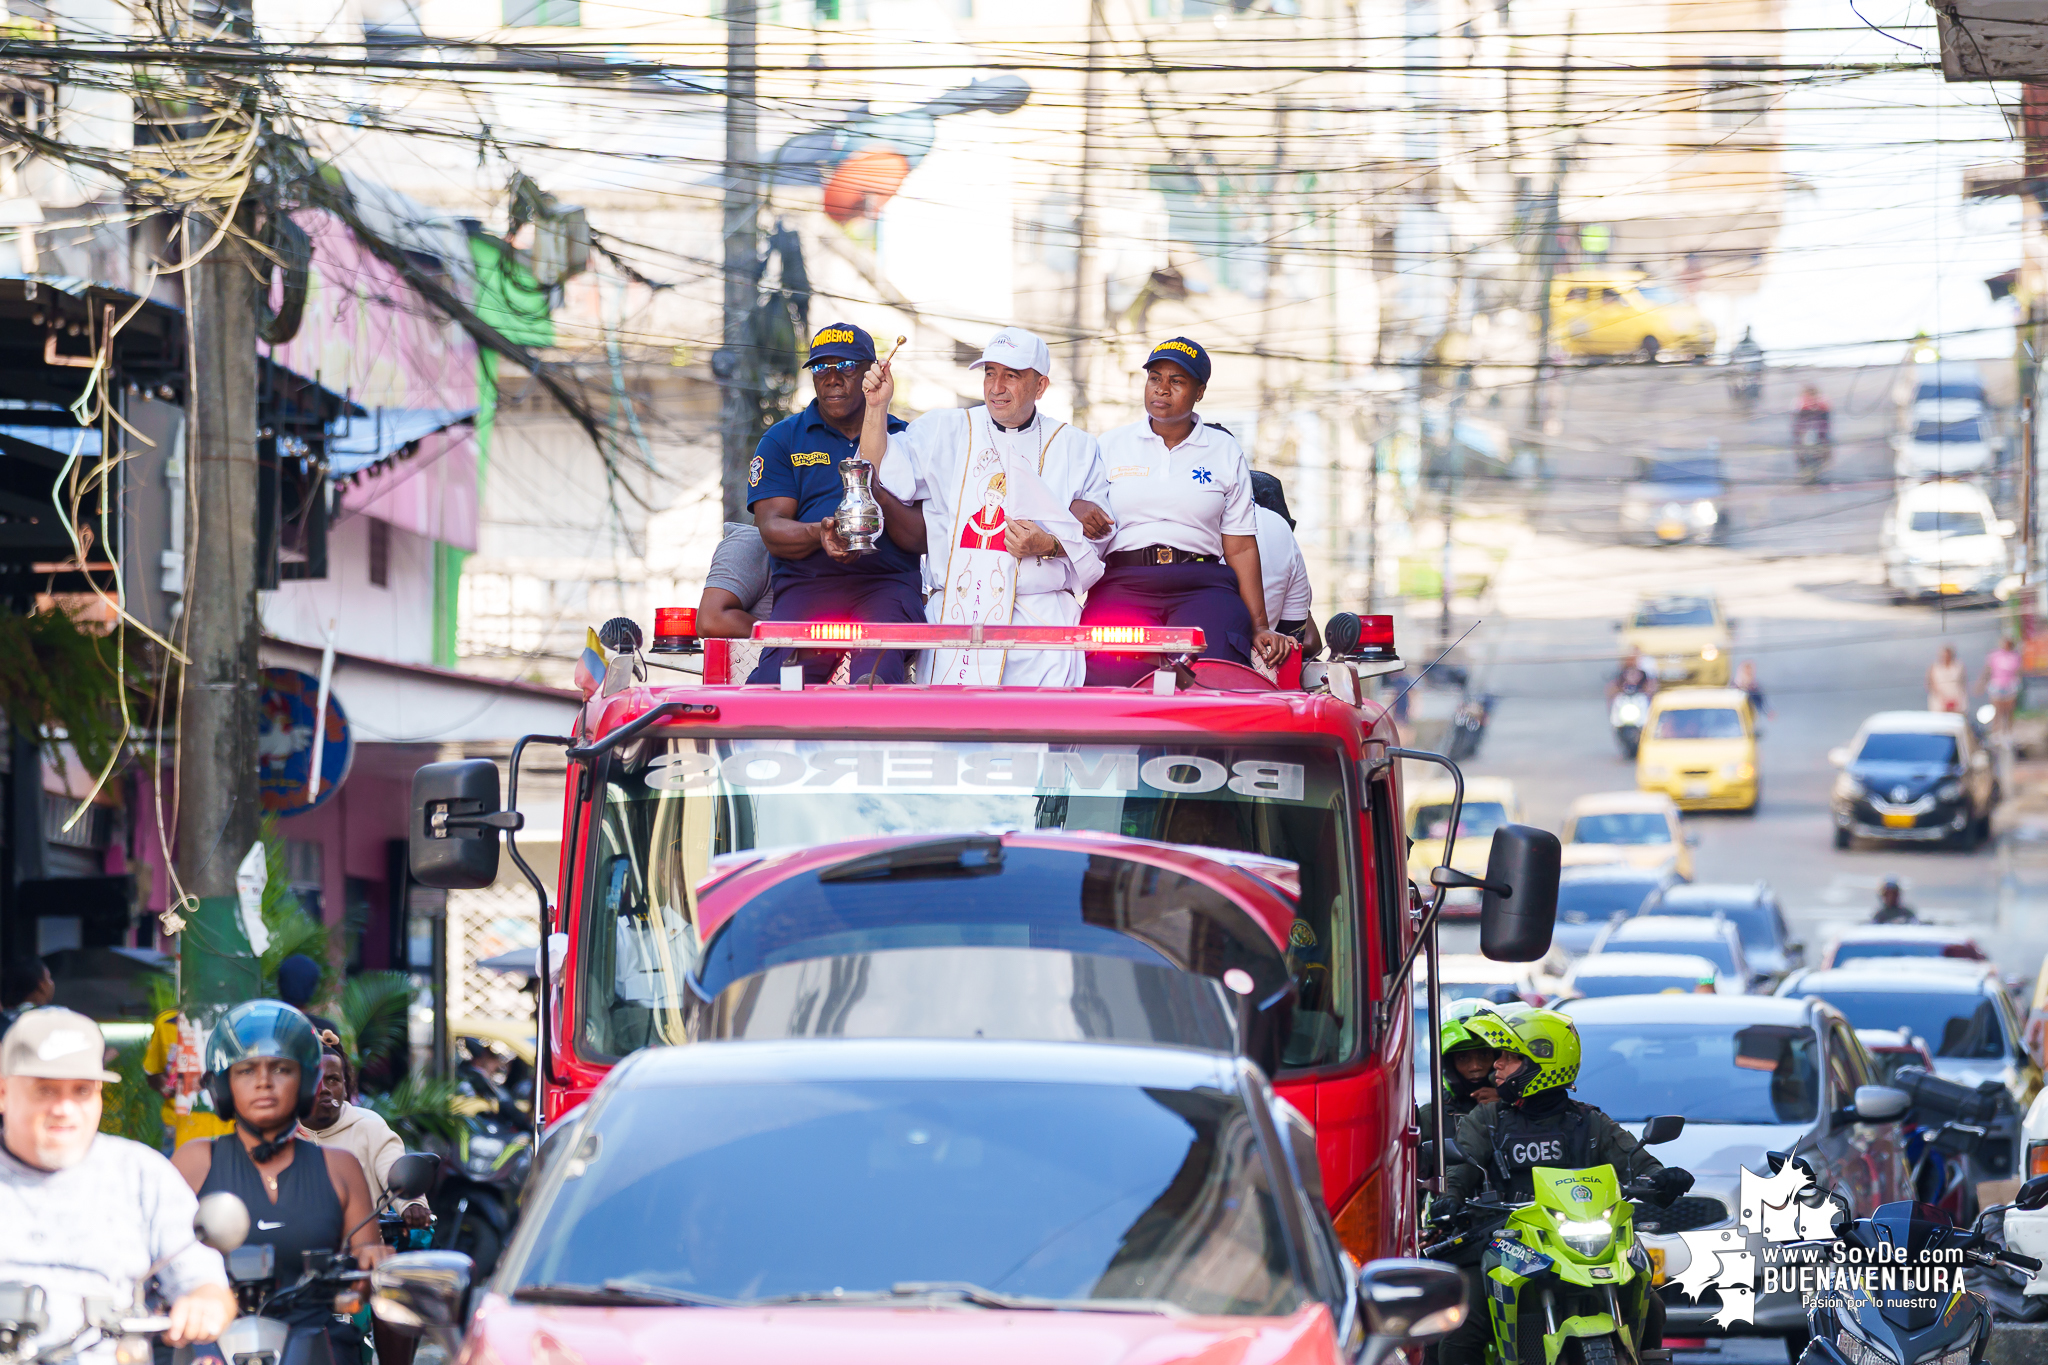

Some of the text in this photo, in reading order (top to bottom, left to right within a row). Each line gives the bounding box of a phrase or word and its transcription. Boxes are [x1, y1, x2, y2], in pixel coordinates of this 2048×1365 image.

[811, 329, 854, 348] BOMBEROS
[1153, 341, 1198, 359] BOMBEROS
[1513, 1140, 1562, 1164] GOES
